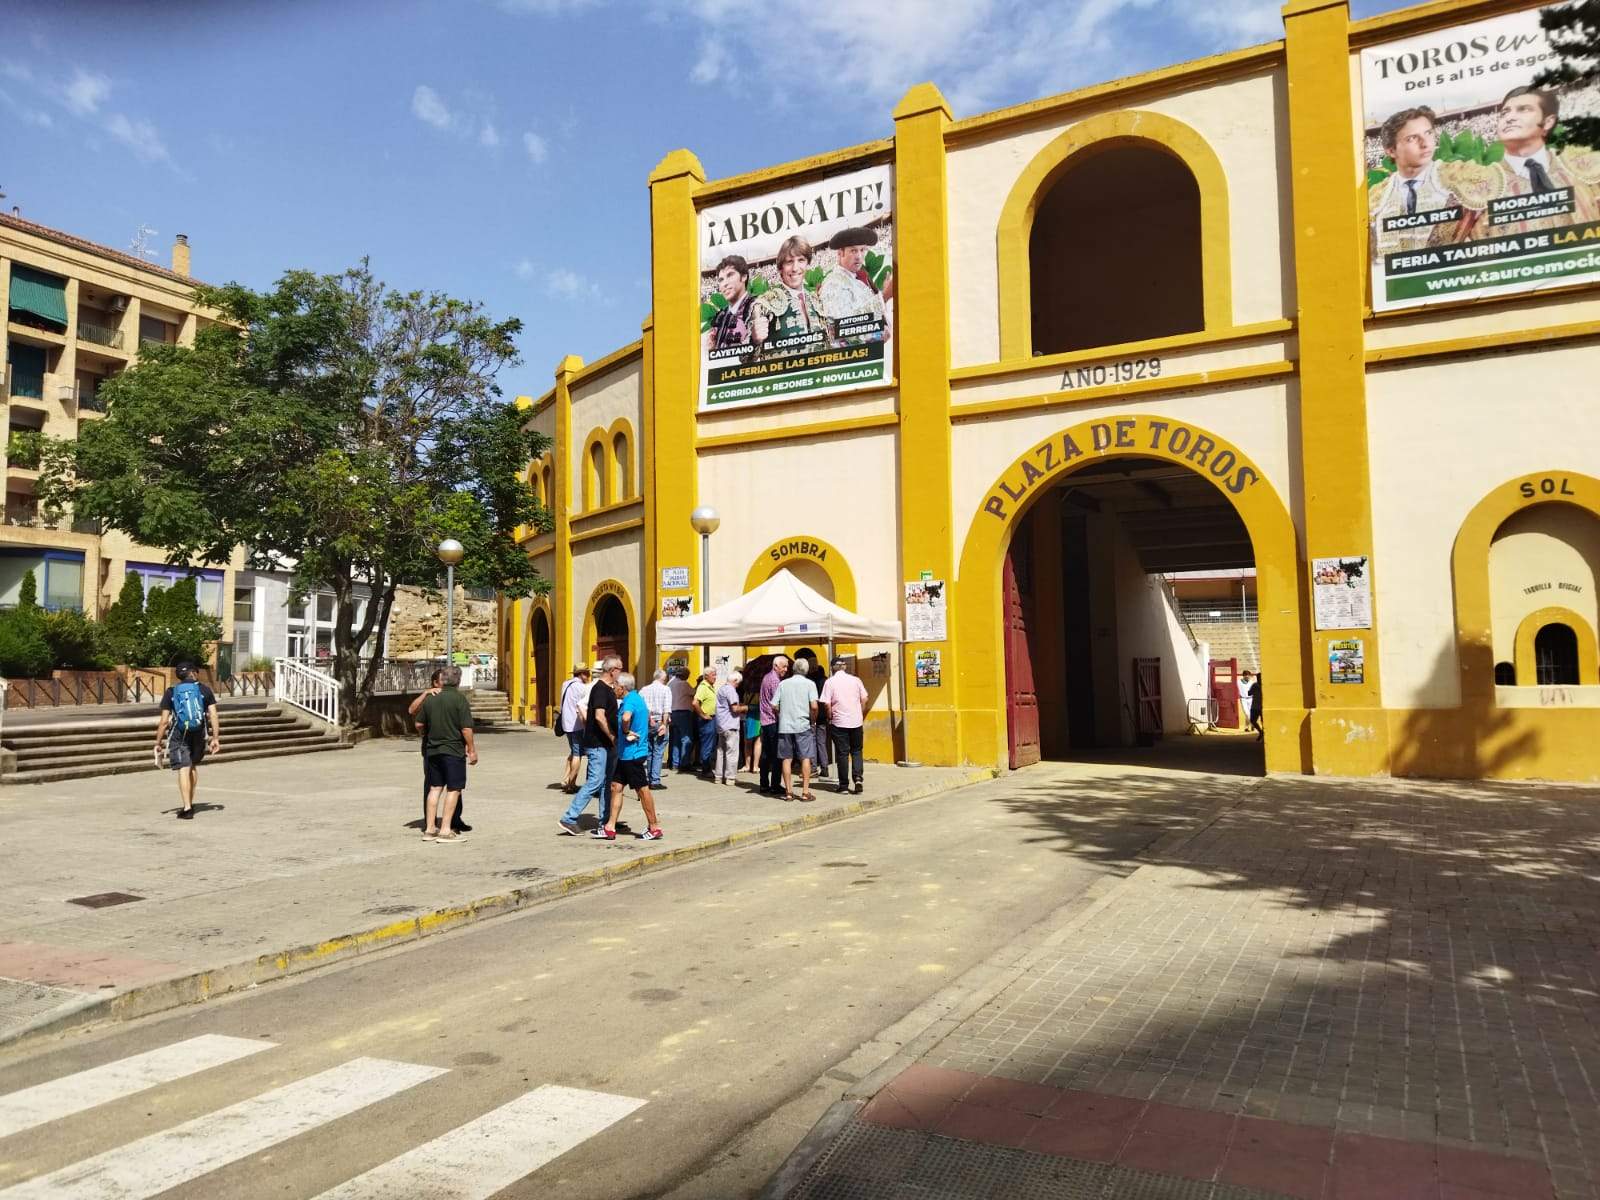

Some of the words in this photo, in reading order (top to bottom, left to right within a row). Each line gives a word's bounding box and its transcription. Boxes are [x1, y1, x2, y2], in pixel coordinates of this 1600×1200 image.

[1375, 35, 1490, 79] TOROS
[1495, 32, 1538, 54] en
[1405, 76, 1430, 92] Del
[1436, 75, 1445, 85] 5
[1450, 70, 1464, 82] al
[1469, 66, 1485, 77] 15
[1490, 61, 1510, 73] de
[1516, 48, 1562, 67] agos
[1493, 190, 1569, 212] MORANTE
[708, 181, 884, 247] ¡ABÓNATE!
[1387, 216, 1427, 230] ROCA
[1430, 209, 1458, 223] REY
[1510, 213, 1526, 222] LA
[1527, 204, 1569, 219] PUEBLA
[1392, 254, 1441, 270] FERIA
[1443, 240, 1521, 263] TAURINA
[1524, 235, 1550, 250] DE
[1553, 231, 1578, 245] LA
[839, 314, 870, 326] ANTONIO
[839, 322, 881, 337] FERRERA
[764, 341, 775, 350] EL
[776, 333, 824, 348] CORDOBÉS
[709, 345, 754, 360] CAYETANO
[721, 370, 737, 380] ¡LA
[739, 365, 767, 376] FERIA
[770, 361, 784, 372] DE
[785, 358, 805, 369] LAS
[807, 347, 869, 366] ESTRELLAS!
[711, 392, 717, 400] 4
[719, 386, 763, 400] CORRIDAS
[772, 379, 814, 392] REJONES
[823, 368, 879, 384] NOVILLADA
[984, 433, 1083, 521] PLAZA
[1090, 420, 1137, 451] DE
[1148, 421, 1260, 494] TOROS
[1520, 478, 1575, 498] SOL
[770, 541, 827, 562] SOMBRA
